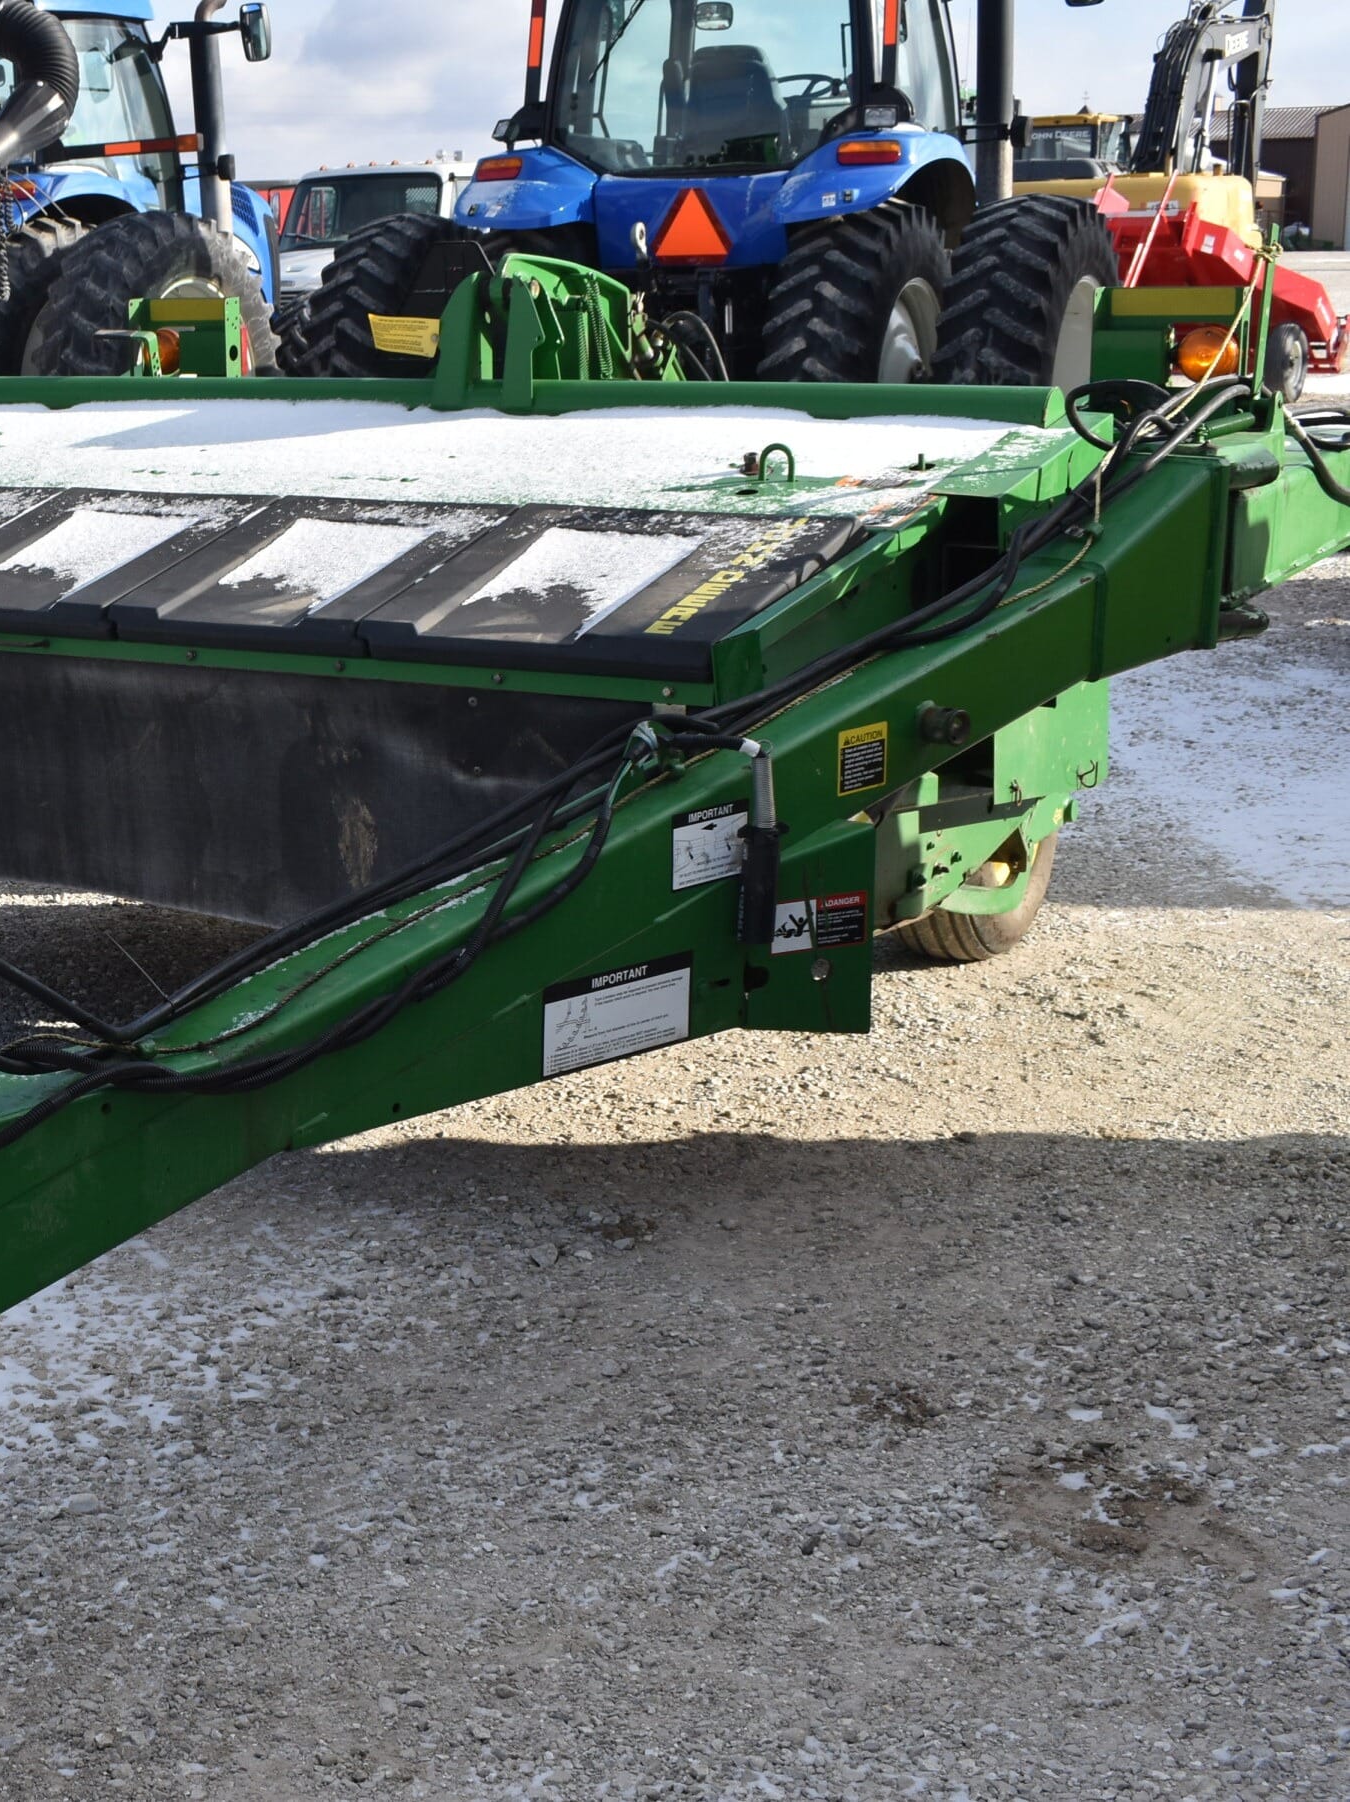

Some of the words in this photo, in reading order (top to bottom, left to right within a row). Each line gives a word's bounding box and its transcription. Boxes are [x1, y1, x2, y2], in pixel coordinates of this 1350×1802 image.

[1031, 132, 1053, 140] OHN
[643, 570, 745, 635] DEERE
[850, 729, 883, 744] CAUTION
[688, 803, 734, 823] IMPORTANT
[828, 895, 860, 907] DANGER
[591, 965, 649, 989] IMPORTANT
